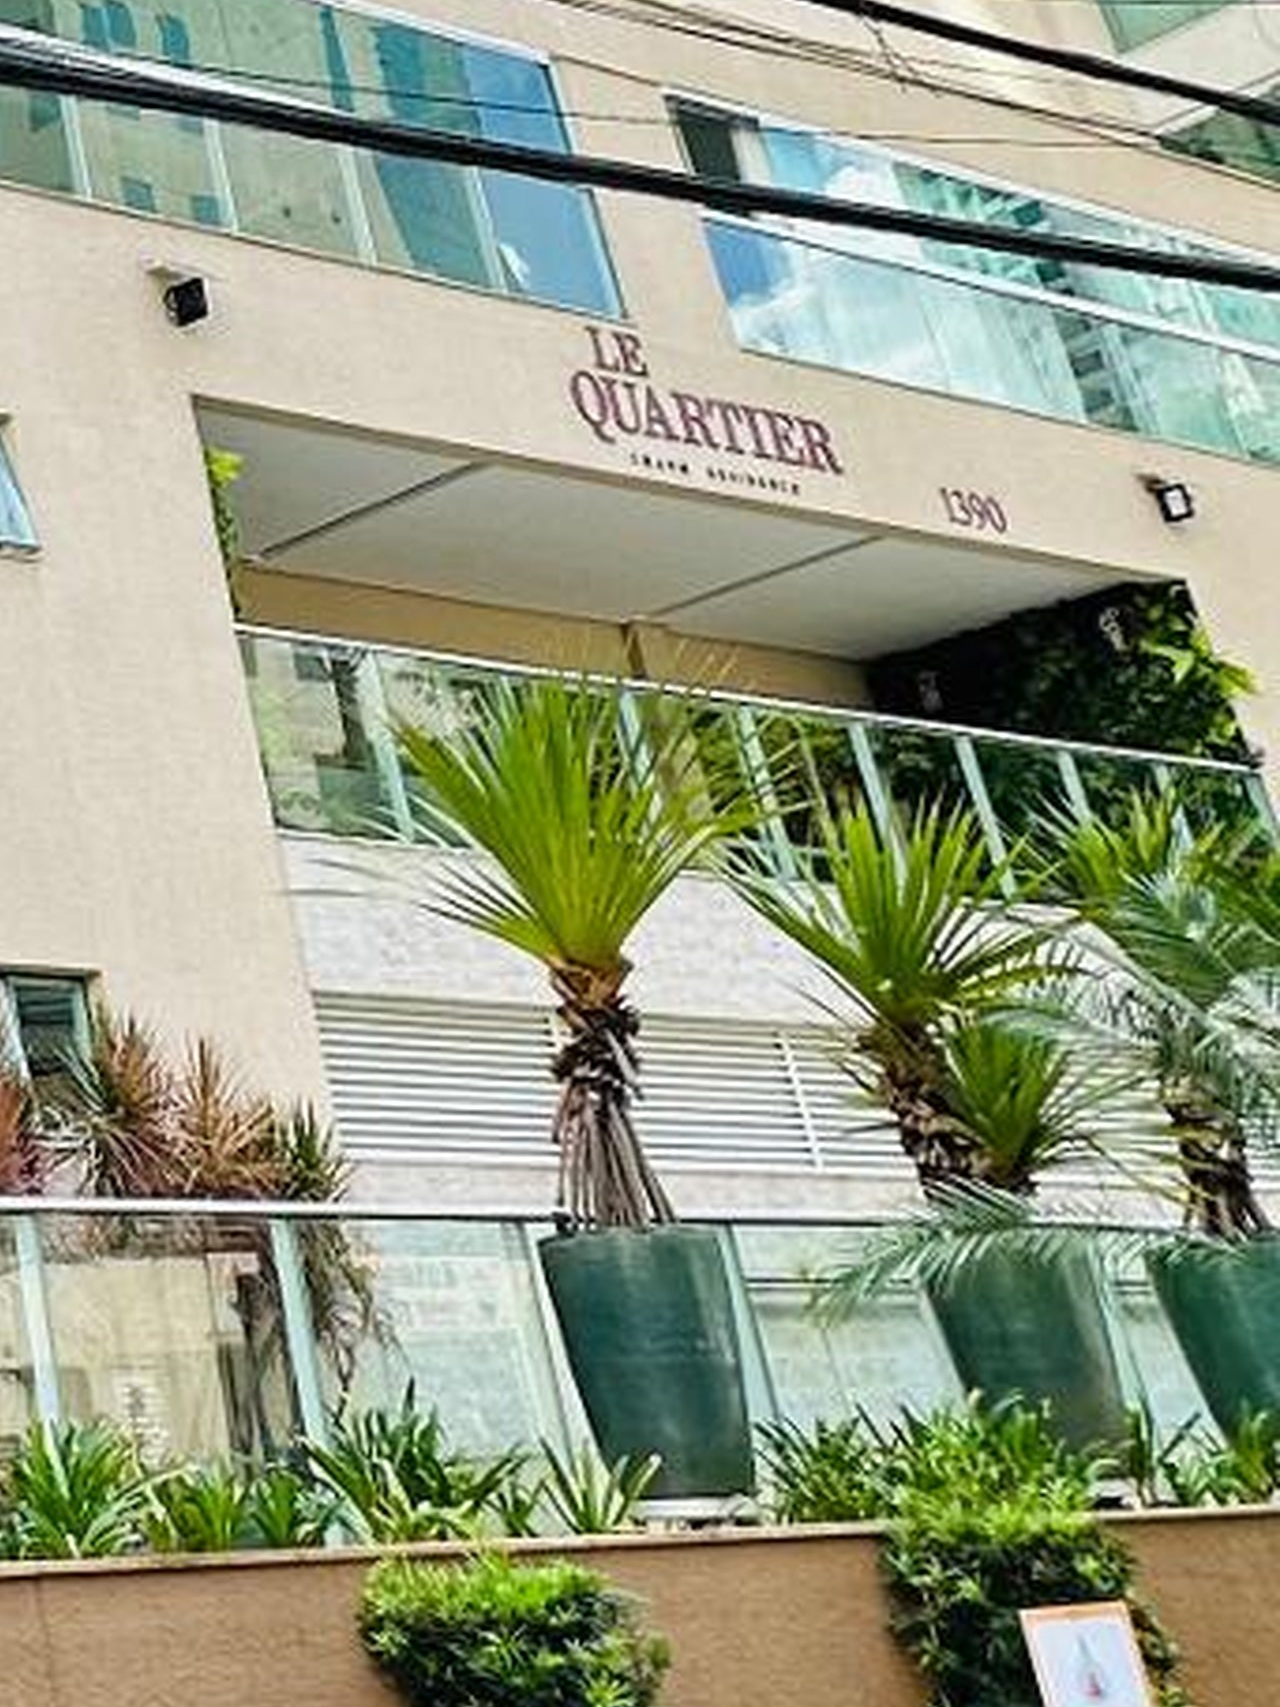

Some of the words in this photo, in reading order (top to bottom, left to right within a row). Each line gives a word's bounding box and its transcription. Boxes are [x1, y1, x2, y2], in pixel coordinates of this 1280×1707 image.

[585, 325, 649, 378] LE
[570, 370, 844, 475] QUARTIER
[940, 487, 1007, 535] 1390
